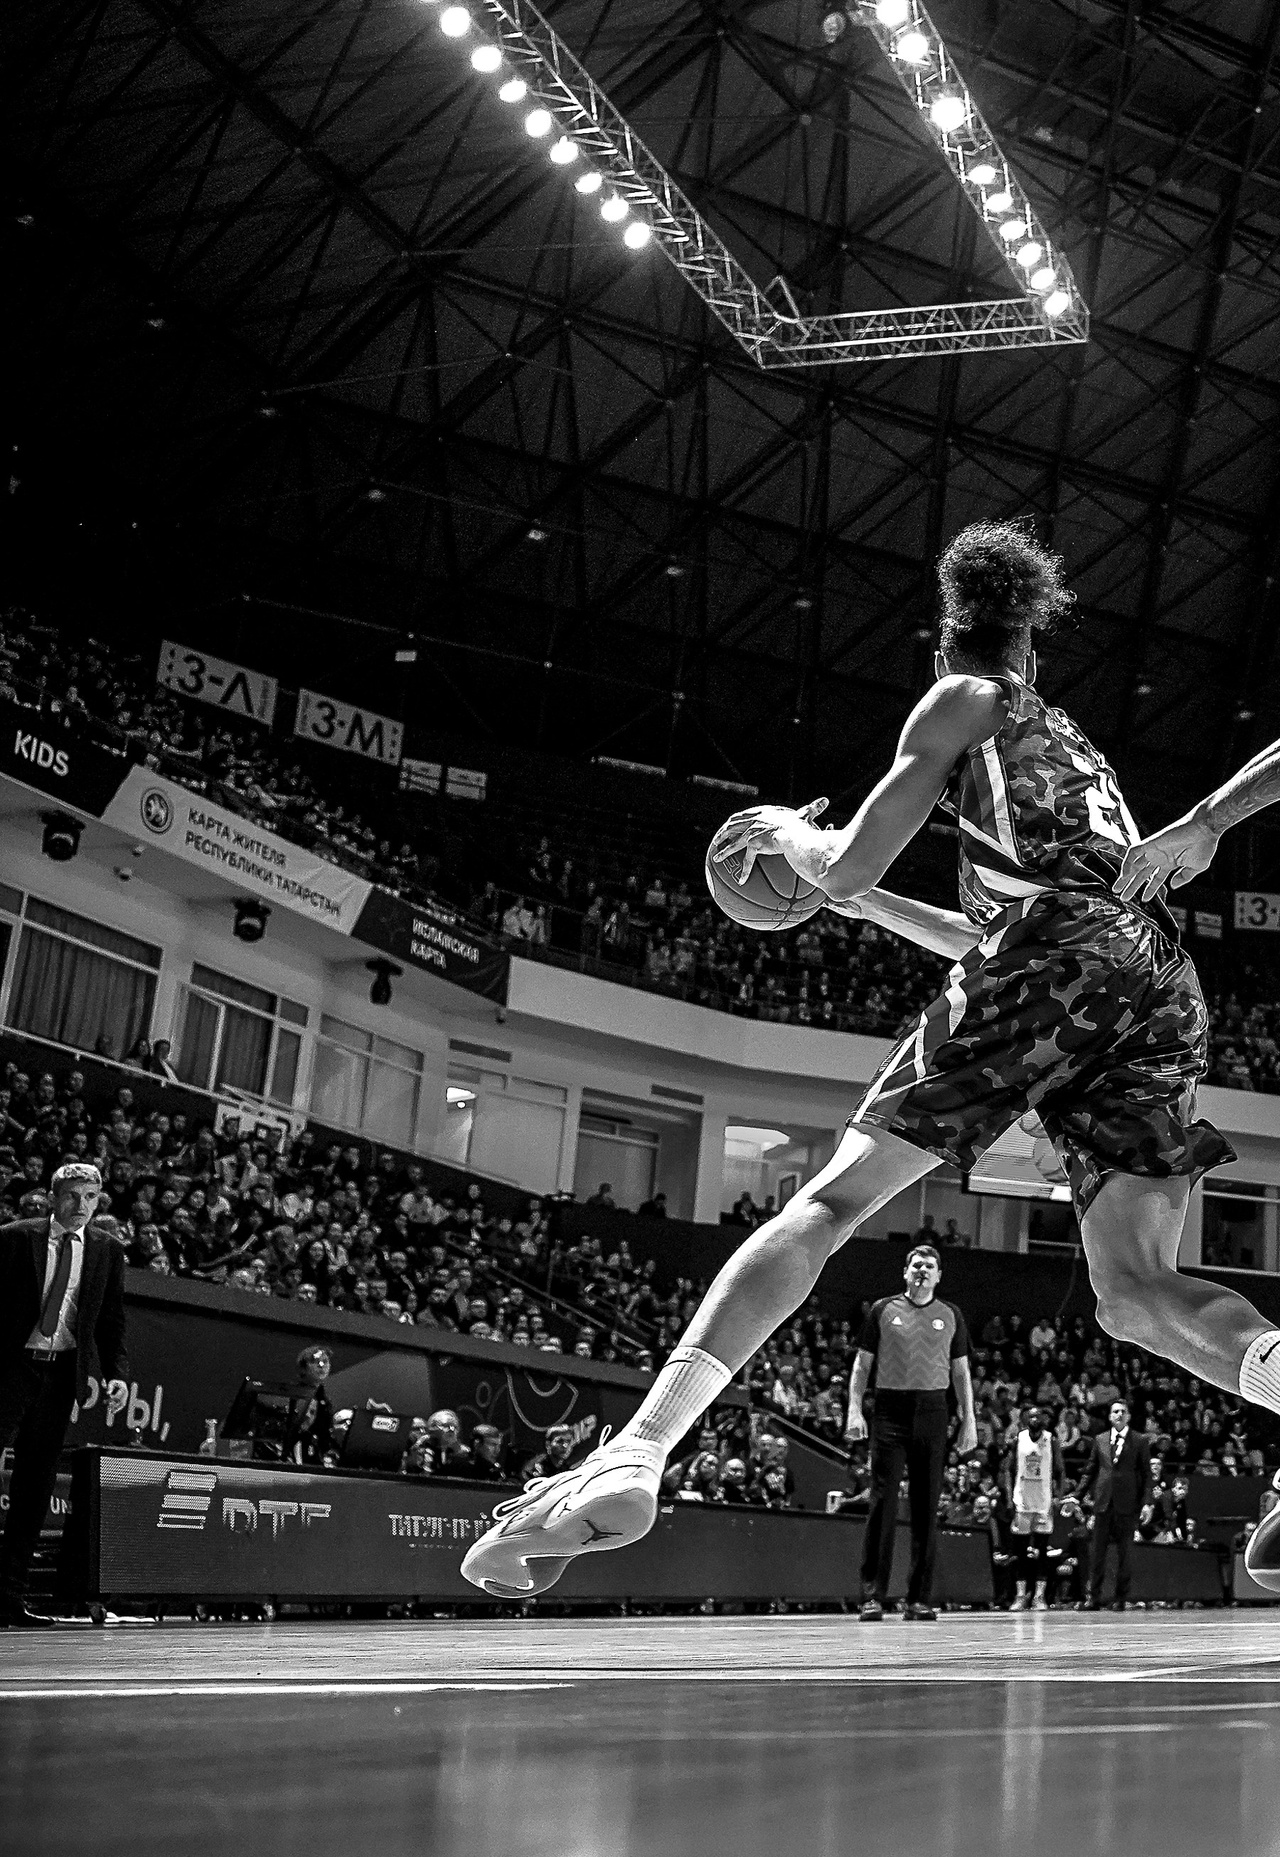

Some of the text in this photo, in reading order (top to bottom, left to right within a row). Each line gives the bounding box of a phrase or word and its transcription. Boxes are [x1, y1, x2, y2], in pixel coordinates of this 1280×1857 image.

[14, 729, 70, 777] KIDS
[187, 807, 287, 871] КАРТА ЖИТЕЛЯ
[185, 830, 341, 917] РЕСПУБЛИКИ ТАТАРСТАН
